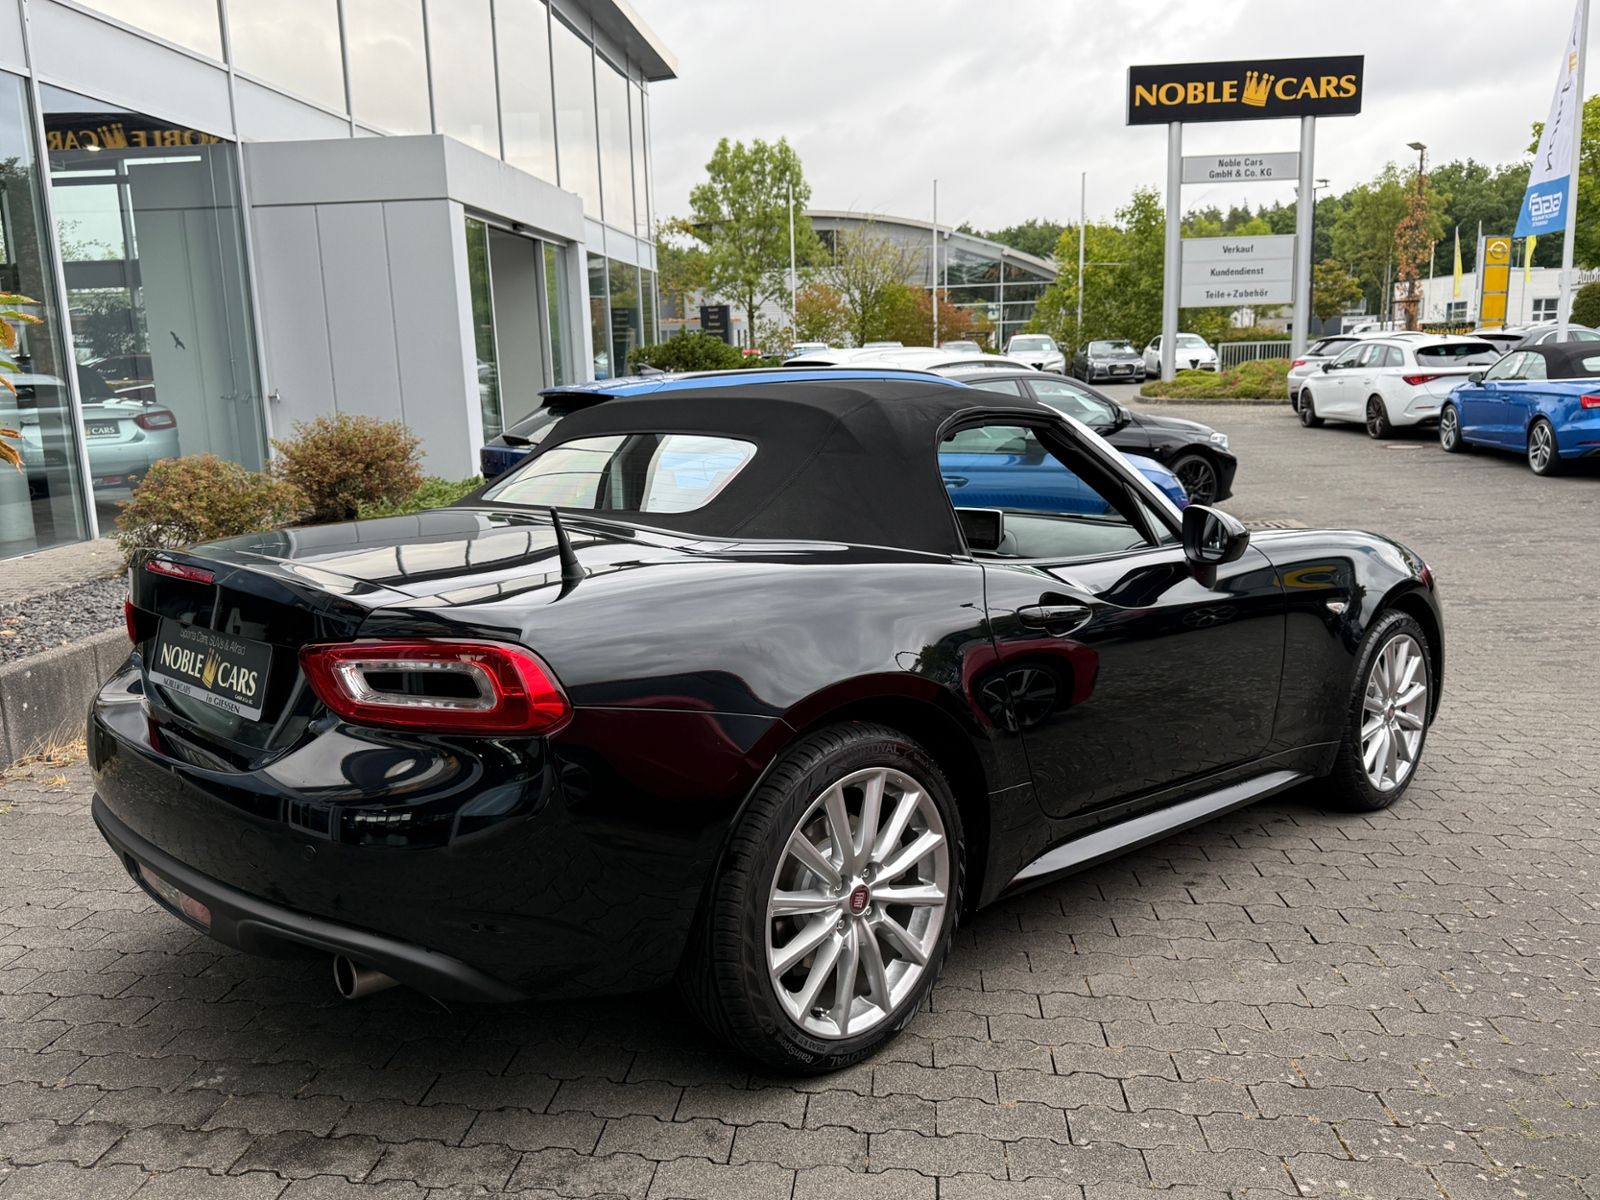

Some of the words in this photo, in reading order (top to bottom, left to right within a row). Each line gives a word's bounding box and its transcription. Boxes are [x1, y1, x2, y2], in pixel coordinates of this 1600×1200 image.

[1134, 80, 1238, 107] NOBLE
[1274, 74, 1357, 101] CARS
[1218, 158, 1241, 168] Noble
[1244, 157, 1263, 167] Cars
[1208, 169, 1233, 179] GmbH
[1235, 169, 1242, 178] &
[1244, 168, 1258, 178] Co.
[1260, 168, 1272, 177] KG
[1222, 244, 1254, 254] Verkauf
[1210, 266, 1264, 277] Kundendienst
[91, 426, 115, 435] CARS
[160, 642, 204, 678] NOBLE
[217, 661, 258, 697] CARS
[214, 695, 241, 714] GIESSEN
